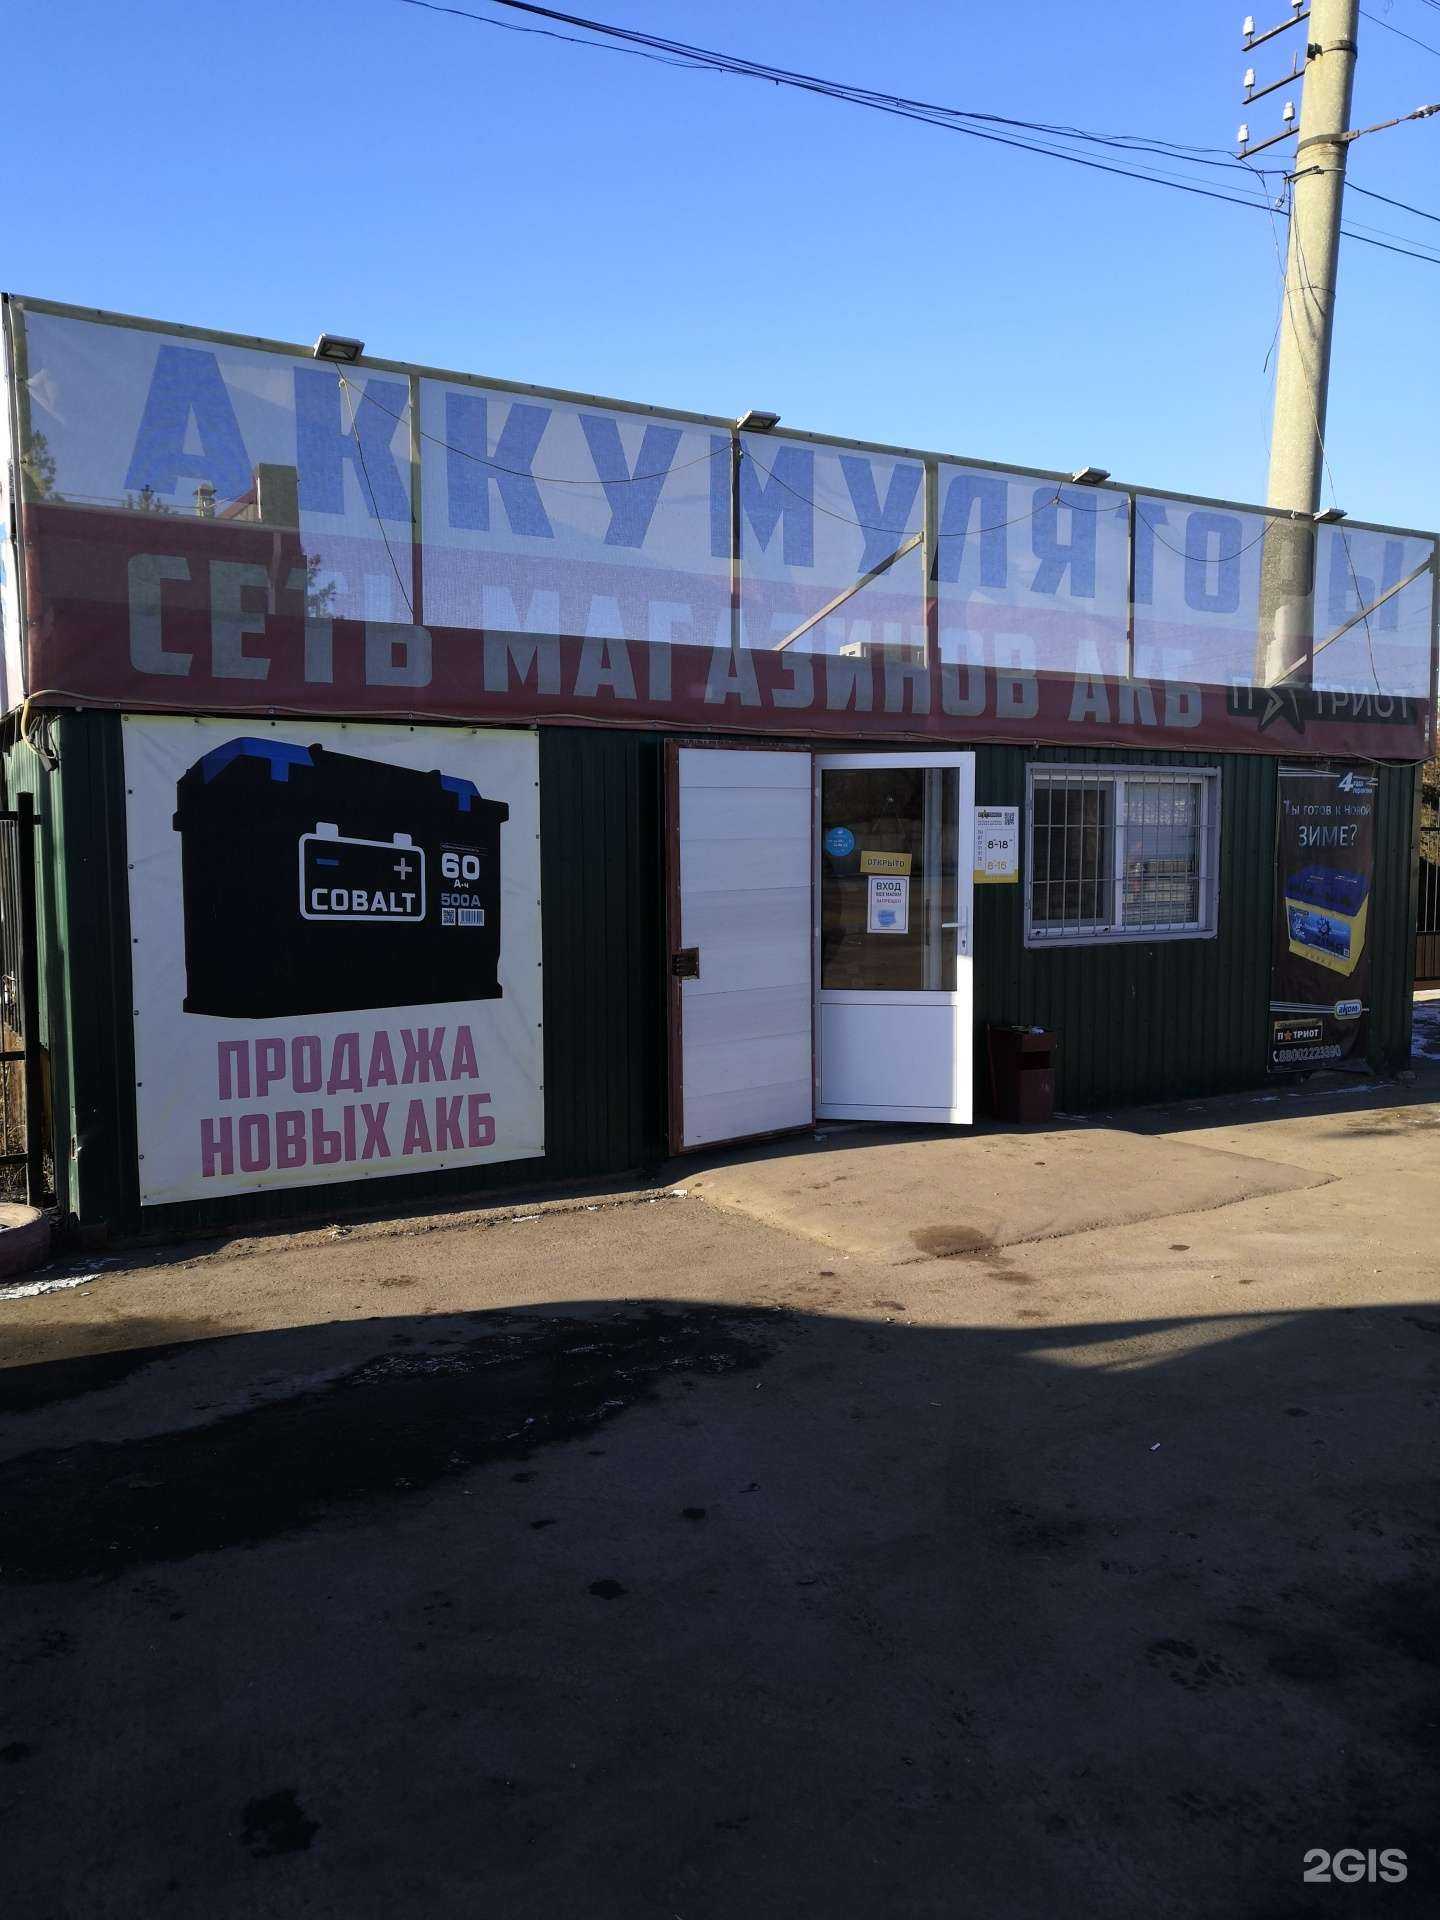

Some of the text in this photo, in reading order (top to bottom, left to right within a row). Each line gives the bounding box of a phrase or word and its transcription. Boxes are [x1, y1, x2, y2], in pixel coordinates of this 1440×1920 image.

[128, 552, 1202, 728] СЕТЬ МАГАЗИНОВ АКБ
[1303, 804, 1332, 816] готов
[1298, 824, 1358, 847] ЗИМЕ?
[440, 852, 481, 880] 60
[867, 858, 905, 868] ОТКРЫТО
[311, 887, 416, 913] COBALT
[876, 882, 901, 892] ВХОД
[217, 1025, 480, 1100] ПРОДАЖА
[200, 1092, 496, 1178] НОВЫХ АКБ
